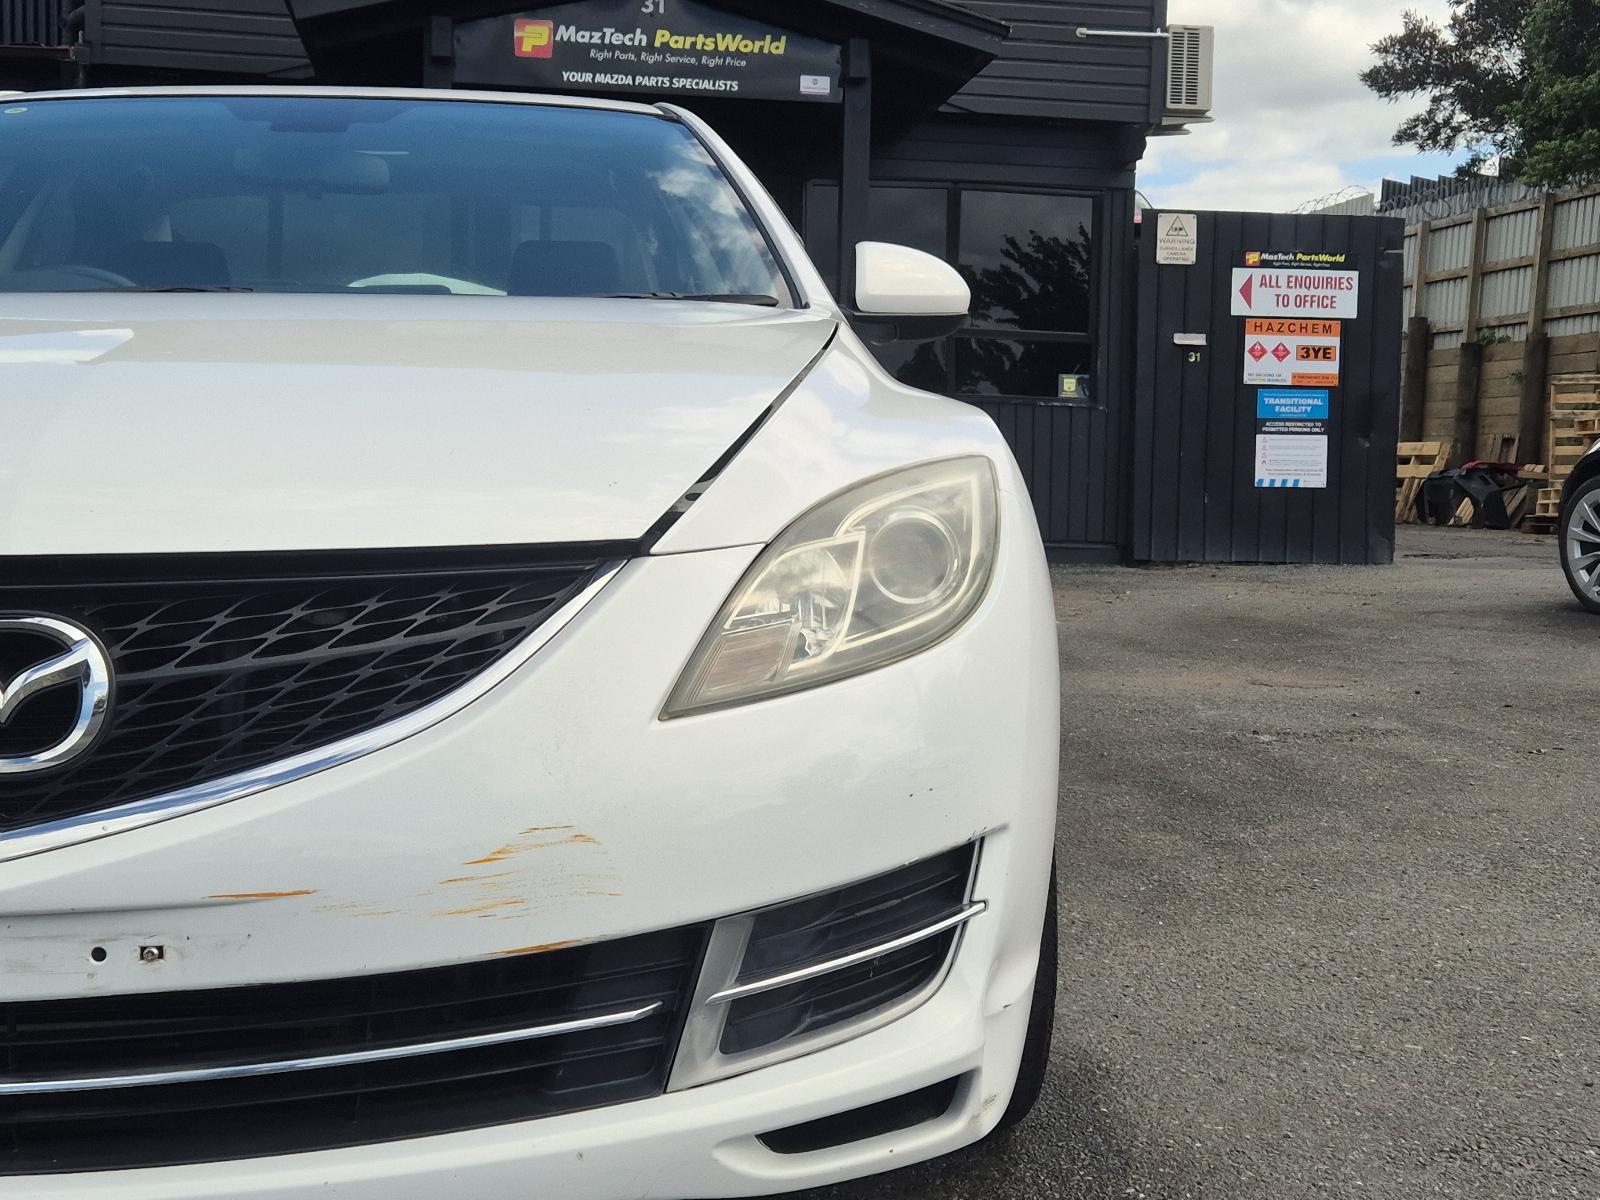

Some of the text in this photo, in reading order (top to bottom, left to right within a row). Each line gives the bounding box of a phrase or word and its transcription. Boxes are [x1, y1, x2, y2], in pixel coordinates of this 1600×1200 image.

[641, 0, 665, 14] 31
[555, 25, 787, 55] MazTech PartsWorld
[589, 49, 747, 68] Right Parts, Right Service, Right Price
[562, 71, 739, 91] YOUR MAZDA PARTS SPECIALISTS
[1296, 253, 1345, 263] PartsWorld
[1259, 274, 1354, 291] ALL ENQUIRIES
[1275, 294, 1337, 309] TO OFFICE
[1254, 322, 1332, 334] HAZCHEM
[1188, 351, 1201, 362] 31
[1300, 346, 1332, 360] 3YE
[1263, 397, 1324, 406] TRANSITIONAL
[1275, 405, 1313, 413] FACILITY
